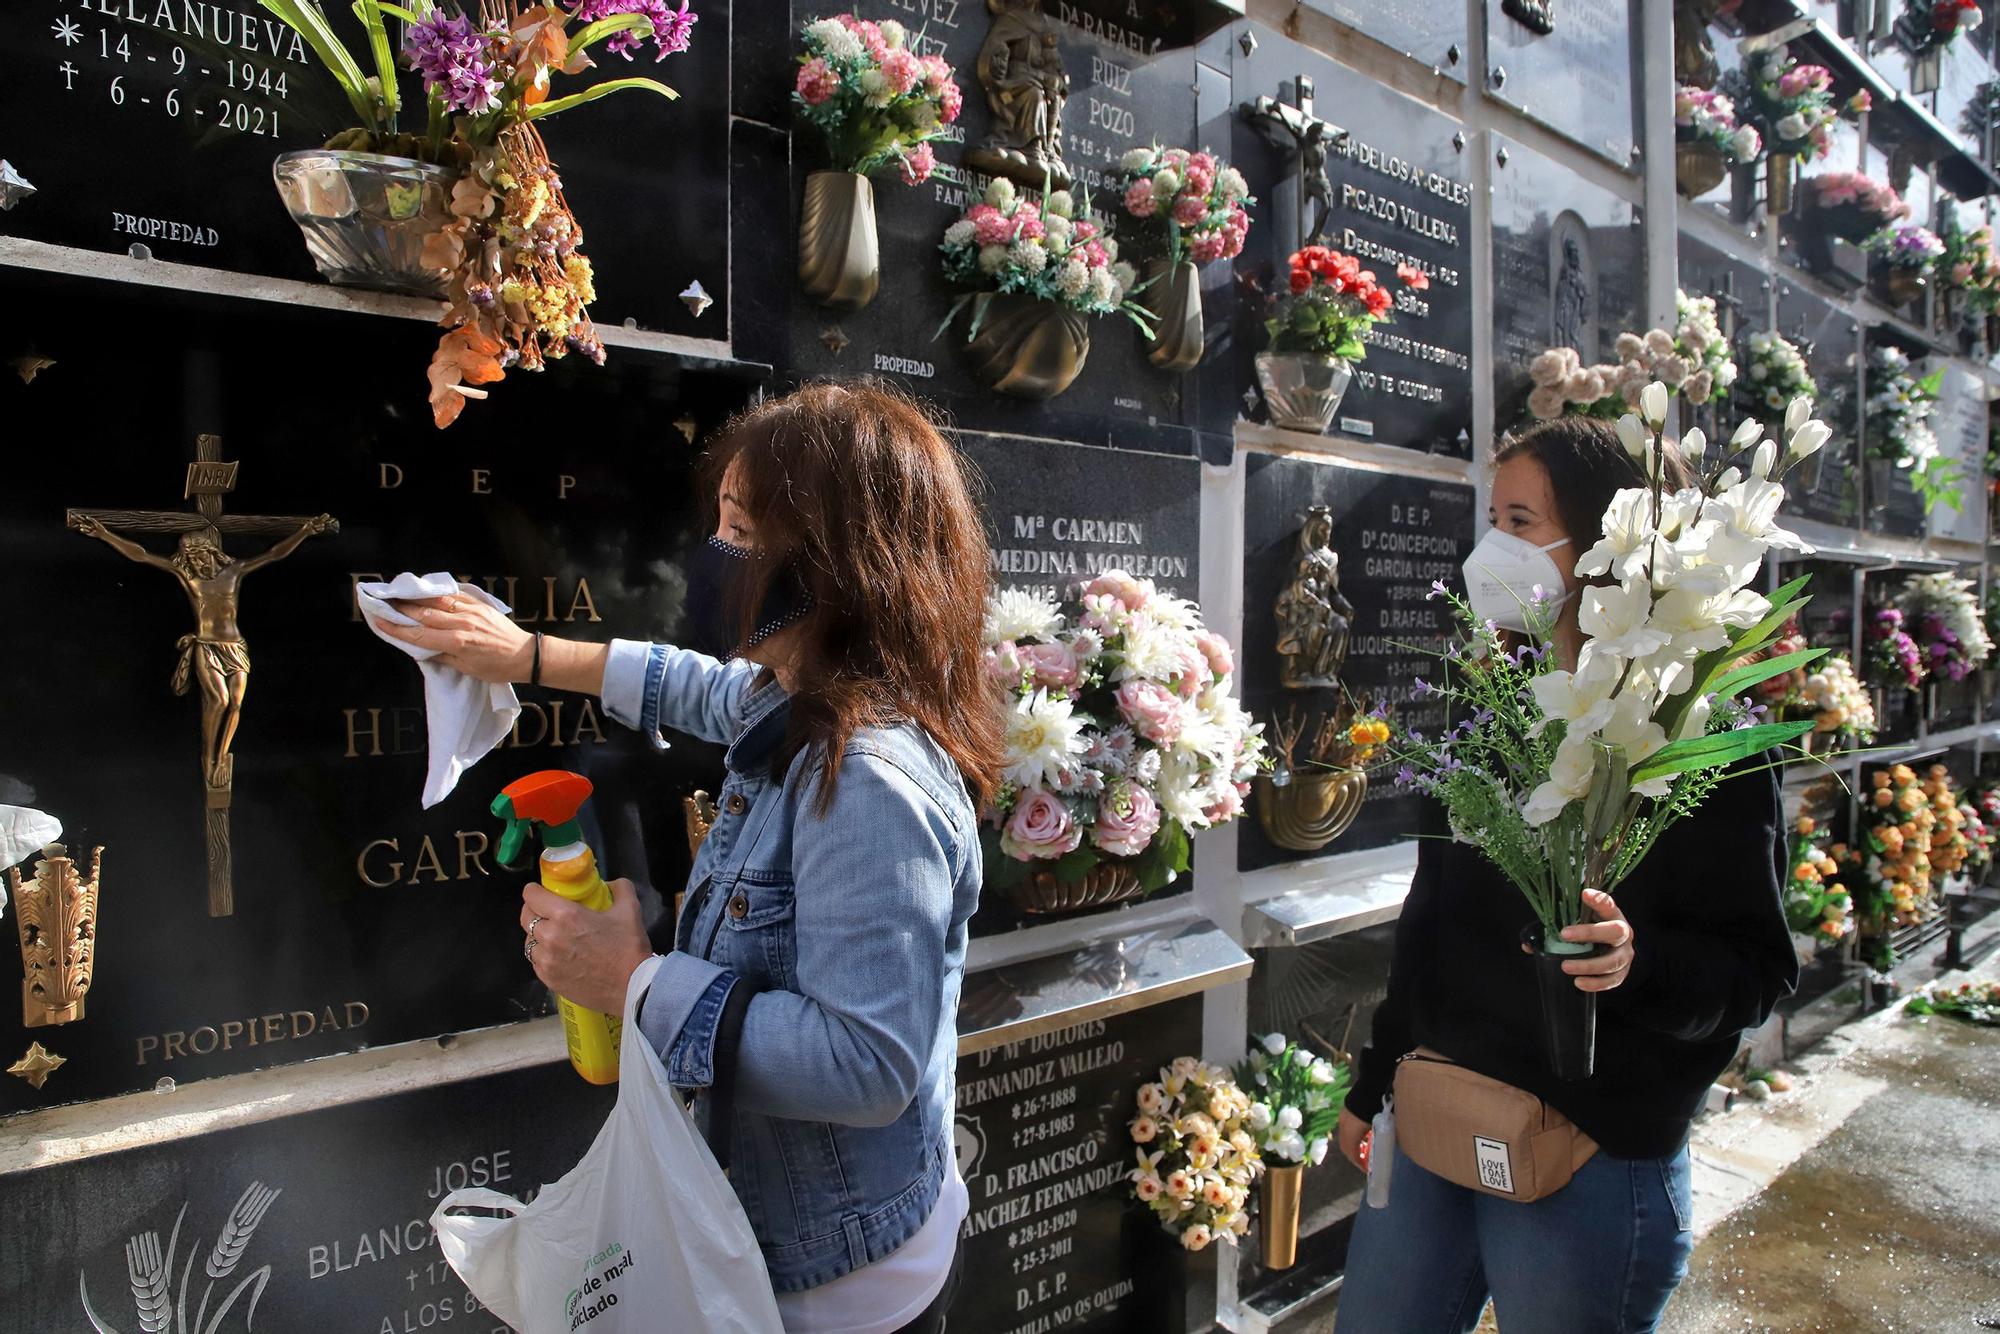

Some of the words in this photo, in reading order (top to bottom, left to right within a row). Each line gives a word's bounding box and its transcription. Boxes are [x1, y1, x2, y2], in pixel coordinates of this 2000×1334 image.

[100, 28, 131, 62] 14
[172, 47, 186, 75] 9
[227, 59, 288, 99] 1944
[1092, 56, 1132, 96] RUIZ
[110, 76, 124, 105] 6
[166, 88, 180, 116] 6
[218, 99, 280, 138] 2021
[1090, 98, 1134, 138] POZO
[1359, 142, 1379, 169] DE
[1380, 152, 1408, 181] LOS
[112, 212, 219, 246] PROPIEDAD
[874, 354, 935, 378] PROPIEDAD
[380, 463, 403, 489] D
[473, 469, 492, 494] E
[560, 475, 576, 499] P
[1052, 517, 1142, 545] CARMEN
[991, 549, 1078, 575] MEDINA
[1086, 552, 1188, 578] MOREJON
[1365, 557, 1413, 579] GARCIA
[1417, 561, 1454, 581] LOPEZ
[1350, 636, 1393, 655] LUQUE
[136, 1001, 370, 1065] PROPIEDAD
[1031, 1019, 1105, 1053] DOLORES
[956, 1059, 1055, 1109] FERNANDEZ
[1060, 1040, 1124, 1078] VALLEJO
[427, 1150, 511, 1198] JOSE
[986, 1173, 1003, 1198] D.
[1007, 1140, 1098, 1190] FRANCISCO
[1481, 1158, 1505, 1171] LOVE
[1484, 1176, 1508, 1189] LOVE
[960, 1194, 1031, 1240] ANCHEZ
[1035, 1160, 1126, 1212] FERNANDEZ
[1020, 1208, 1077, 1245] 28-12-1920
[583, 1277, 602, 1296] de
[1017, 1288, 1033, 1312] D.
[1038, 1279, 1051, 1303] E.
[1055, 1272, 1068, 1294] P.
[404, 1298, 455, 1333] LOS
[1054, 1306, 1072, 1328] NO
[1075, 1296, 1091, 1317] OS
